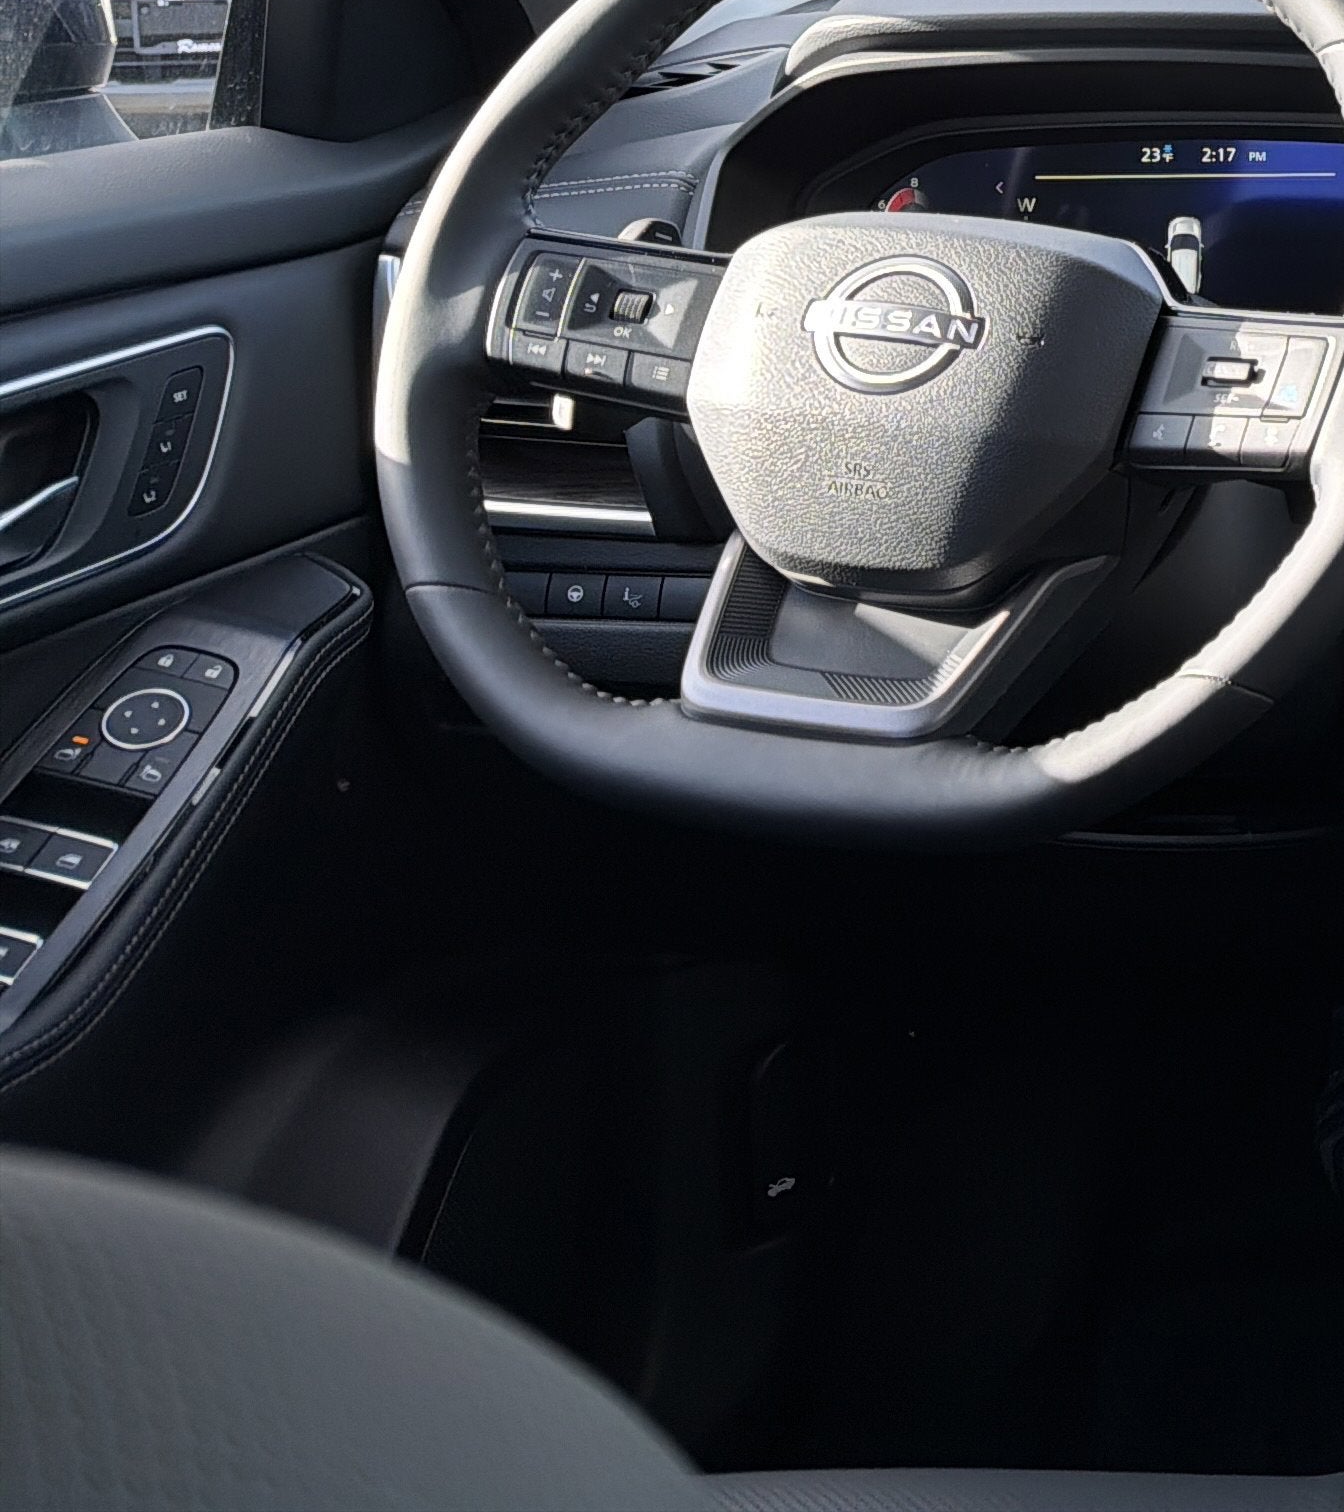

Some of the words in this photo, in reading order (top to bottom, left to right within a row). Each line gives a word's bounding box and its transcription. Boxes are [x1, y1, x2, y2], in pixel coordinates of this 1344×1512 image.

[1201, 147, 1237, 163] 2:17
[1248, 151, 1267, 162] PM
[910, 178, 919, 188] 8
[877, 199, 886, 210] 6
[1016, 197, 1037, 214] W
[820, 305, 979, 344] ISSAN
[613, 326, 632, 338] OK
